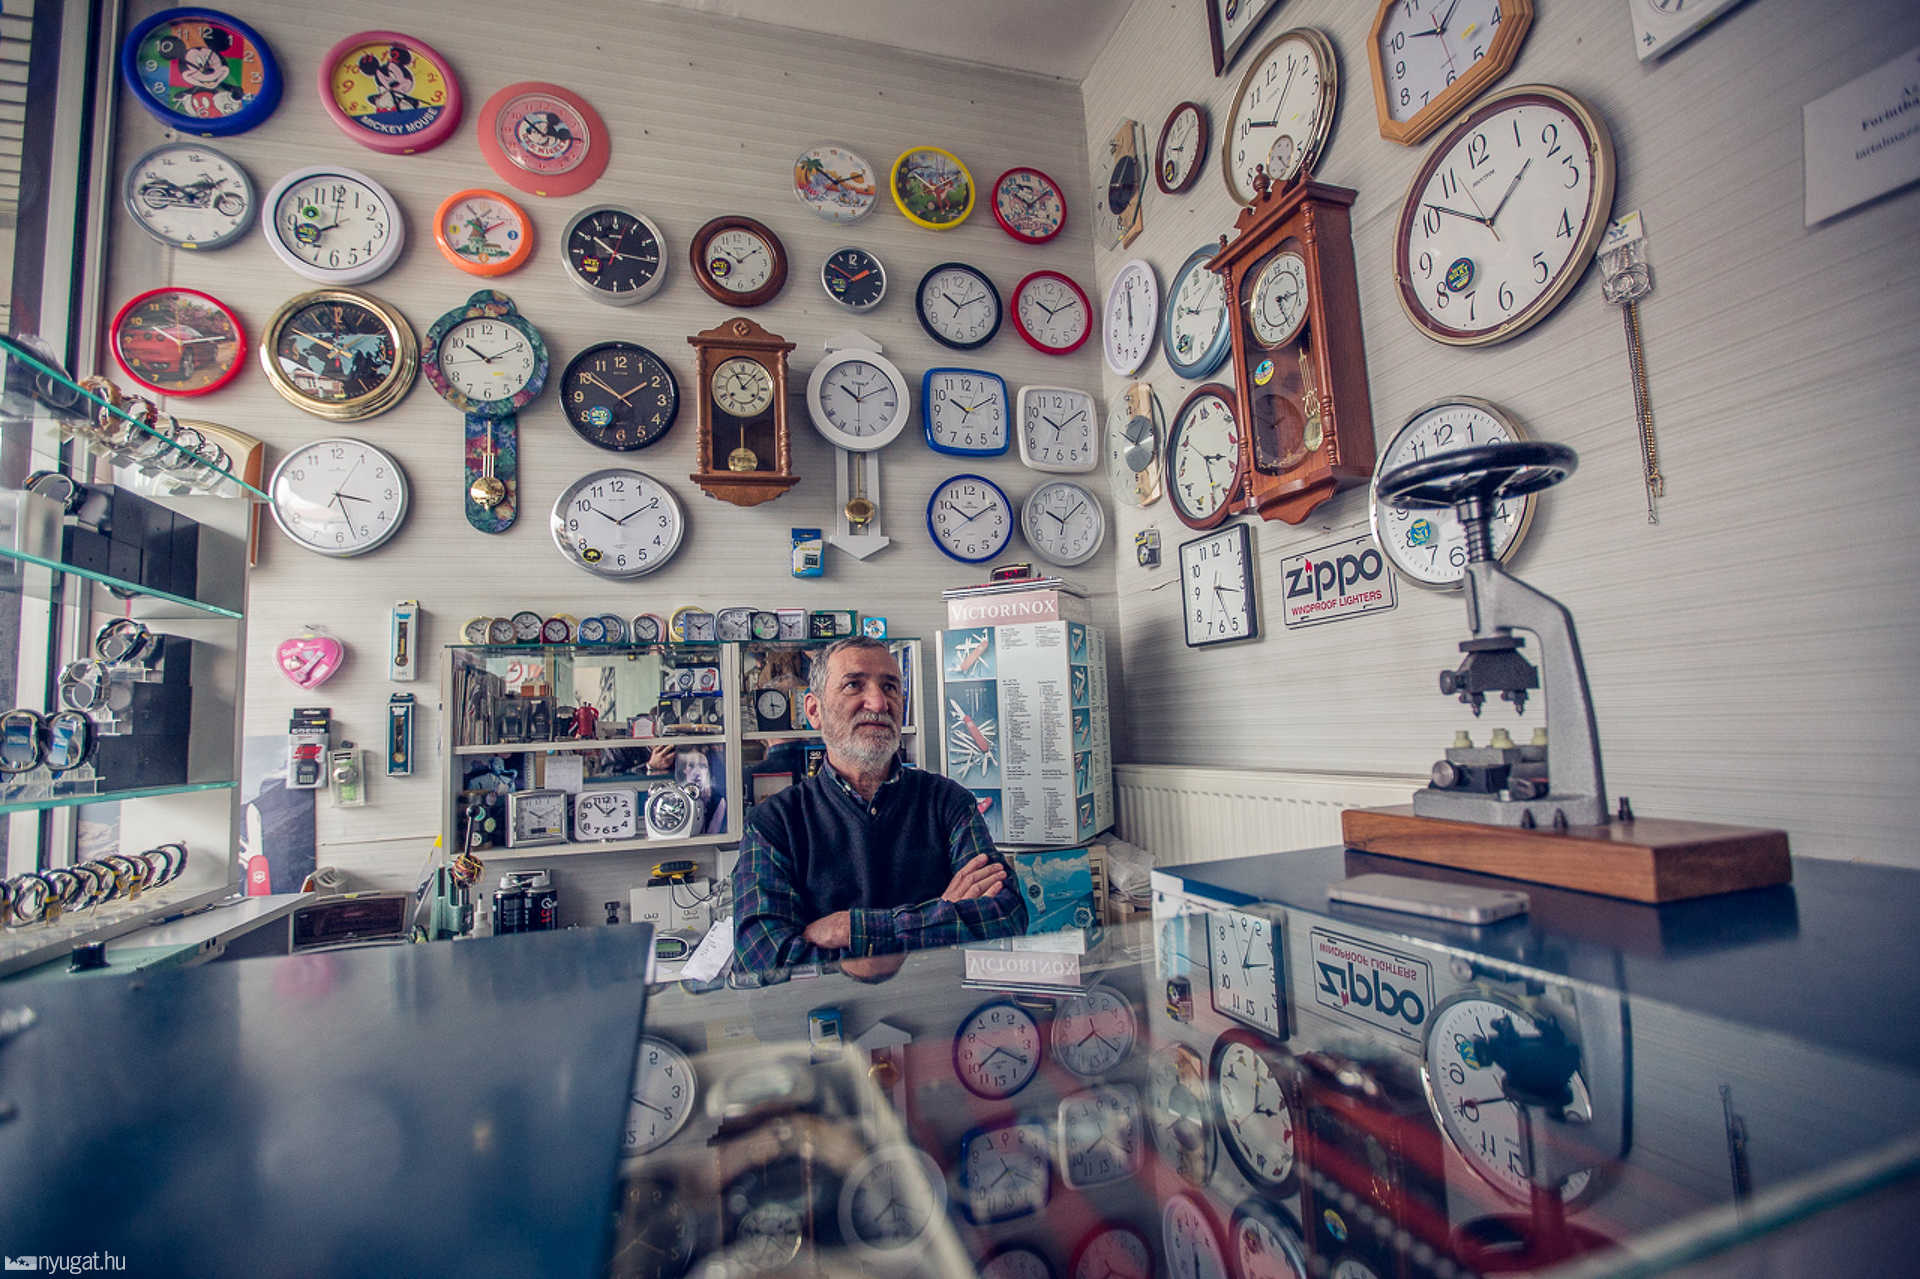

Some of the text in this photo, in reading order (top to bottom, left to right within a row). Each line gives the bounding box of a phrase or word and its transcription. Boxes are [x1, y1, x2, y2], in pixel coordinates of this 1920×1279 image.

[1491, 6, 1502, 26] 4
[176, 28, 189, 40] 11
[197, 26, 213, 39] 12
[155, 40, 174, 52] 10
[1390, 31, 1405, 55] 10
[243, 50, 255, 63] 2
[145, 59, 158, 72] 9
[1396, 61, 1406, 80] 9
[250, 71, 263, 84] 3
[153, 81, 166, 94] 8
[1400, 87, 1411, 106] 8
[406, 107, 438, 133] MOUSE
[1513, 119, 1522, 147] 1
[1541, 124, 1562, 158] 2
[1467, 134, 1490, 170] 12
[1561, 154, 1580, 189] 3
[1441, 167, 1458, 200] 11
[314, 187, 326, 205] 11
[366, 204, 376, 221] 2
[1423, 206, 1441, 240] 10
[1556, 207, 1575, 238] 4
[373, 222, 384, 240] 3
[329, 249, 340, 267] 6
[347, 247, 358, 265] 5
[1418, 251, 1433, 280] 9
[1532, 251, 1549, 284] 5
[1436, 281, 1450, 309] 8
[1498, 280, 1514, 311] 6
[1464, 290, 1476, 322] 7
[595, 360, 606, 372] 11
[614, 355, 628, 368] 12
[651, 375, 660, 387] 2
[945, 379, 954, 390] 11
[961, 379, 971, 392] 12
[573, 390, 584, 403] 9
[656, 394, 667, 406] 3
[935, 389, 946, 401] 10
[934, 404, 941, 416] 9
[993, 409, 1000, 421] 3
[651, 413, 661, 425] 4
[637, 425, 646, 437] 5
[935, 421, 943, 433] 8
[992, 425, 999, 436] 4
[1467, 422, 1475, 443] 1
[616, 429, 626, 441] 6
[950, 431, 957, 443] 7
[965, 433, 973, 445] 6
[980, 433, 988, 445] 5
[1433, 423, 1454, 448] 12
[308, 455, 319, 465] 11
[331, 448, 344, 459] 12
[292, 469, 305, 481] 10
[376, 467, 384, 479] 2
[590, 486, 603, 498] 11
[609, 480, 624, 492] 12
[384, 489, 392, 500] 3
[576, 499, 591, 512] 10
[650, 497, 659, 509] 2
[377, 511, 385, 520] 4
[1496, 502, 1510, 524] 4
[569, 519, 578, 531] 9
[659, 515, 667, 527] 3
[360, 525, 369, 537] 5
[335, 532, 344, 544] 6
[653, 535, 660, 546] 4
[639, 548, 647, 561] 5
[1200, 546, 1207, 561] 11
[1212, 542, 1220, 557] 12
[1425, 544, 1438, 565] 7
[617, 554, 626, 567] 6
[1450, 546, 1465, 567] 6
[1192, 564, 1200, 578] 10
[1195, 587, 1201, 601] 9
[1291, 590, 1383, 616] WINDPROOF LIGHTERS
[949, 599, 1057, 621] VICTORINOX
[1196, 609, 1203, 623] 8
[1207, 621, 1213, 635] 7
[1219, 620, 1225, 634] 6
[1232, 617, 1239, 632] 5
